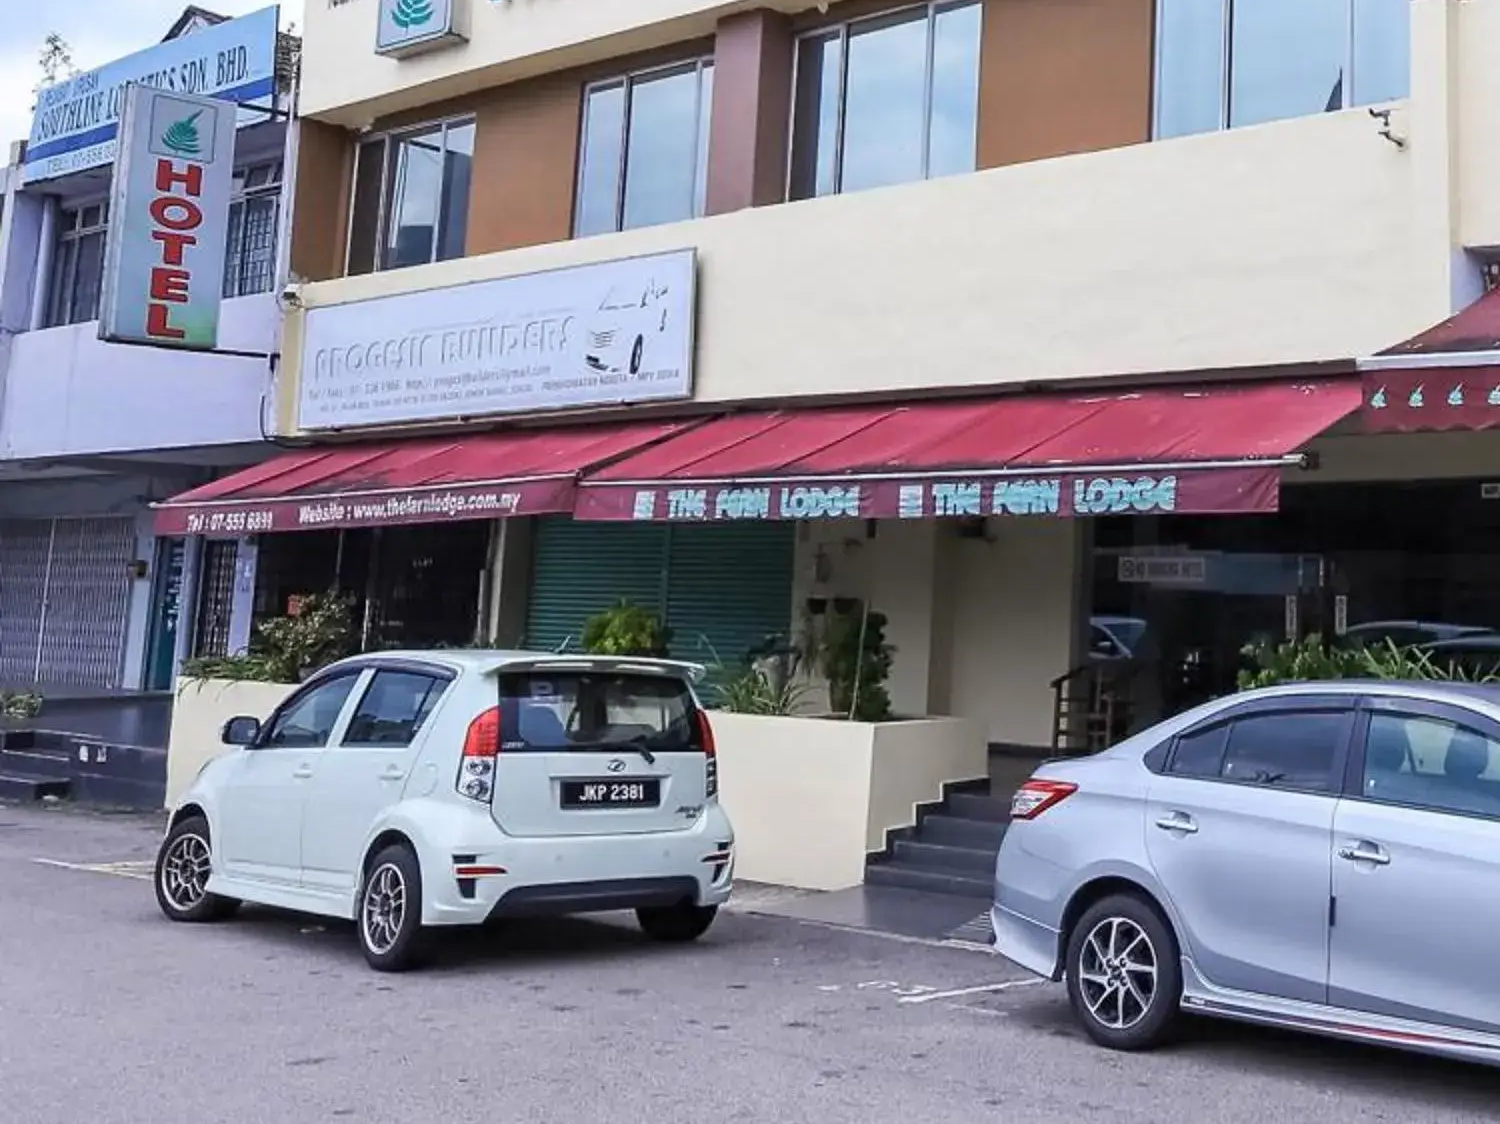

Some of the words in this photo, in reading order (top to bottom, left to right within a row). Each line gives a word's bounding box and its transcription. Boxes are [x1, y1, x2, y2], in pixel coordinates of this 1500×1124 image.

[216, 44, 249, 87] BHD.
[147, 158, 204, 340] HOTEL
[299, 501, 345, 524] Website
[1073, 475, 1177, 513] LODGE
[579, 783, 607, 801] JKP
[610, 782, 644, 801] 2381
